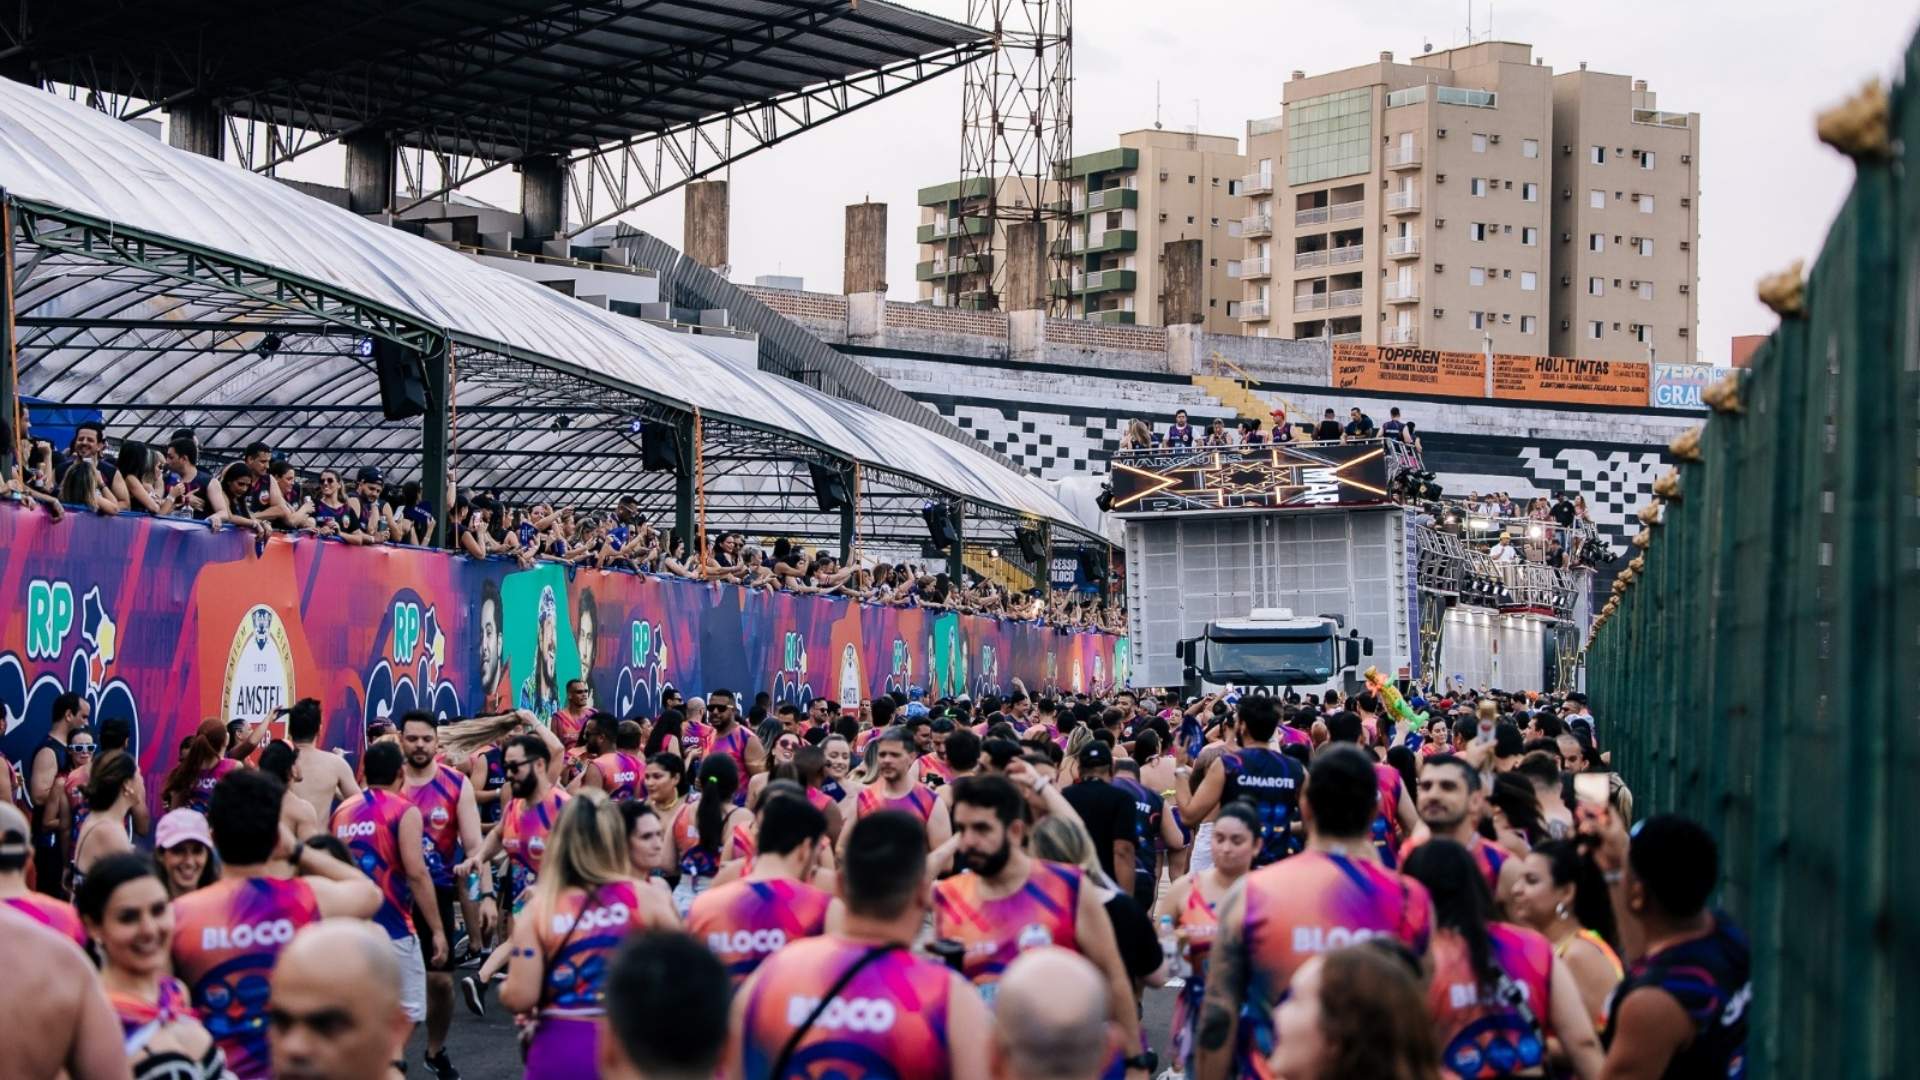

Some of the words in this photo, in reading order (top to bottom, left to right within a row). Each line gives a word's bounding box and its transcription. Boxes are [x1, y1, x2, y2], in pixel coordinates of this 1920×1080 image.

[1377, 346, 1440, 364] TOPPREN
[1656, 366, 1709, 384] ZERO
[1051, 559, 1078, 571] CESSO
[27, 579, 73, 658] RP
[393, 601, 420, 663] RP
[632, 620, 650, 668] RP
[1237, 775, 1295, 789] CAMAROTE
[336, 821, 376, 838] BLOCO
[202, 919, 294, 950] BLOCO
[707, 928, 787, 953] BLOCO
